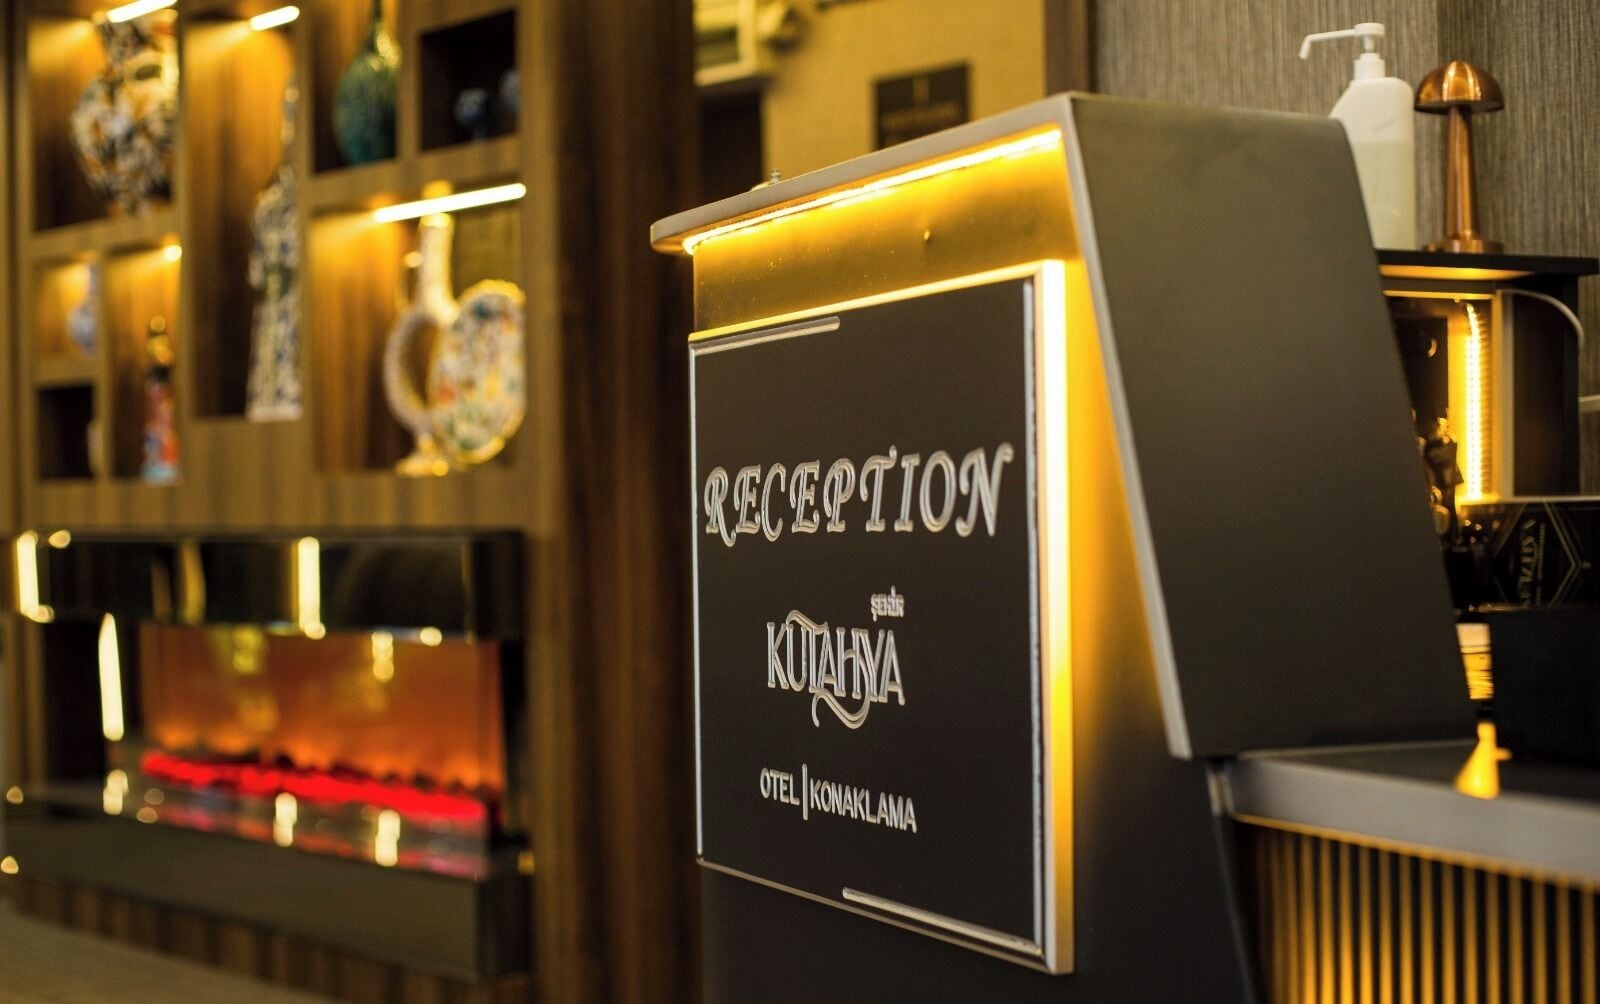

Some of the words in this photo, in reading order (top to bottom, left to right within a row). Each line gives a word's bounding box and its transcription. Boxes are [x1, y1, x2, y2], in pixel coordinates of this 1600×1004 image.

[703, 442, 1014, 548] RECEPTION
[759, 767, 801, 806] OTEL
[809, 777, 918, 833] KONAKLAMA
